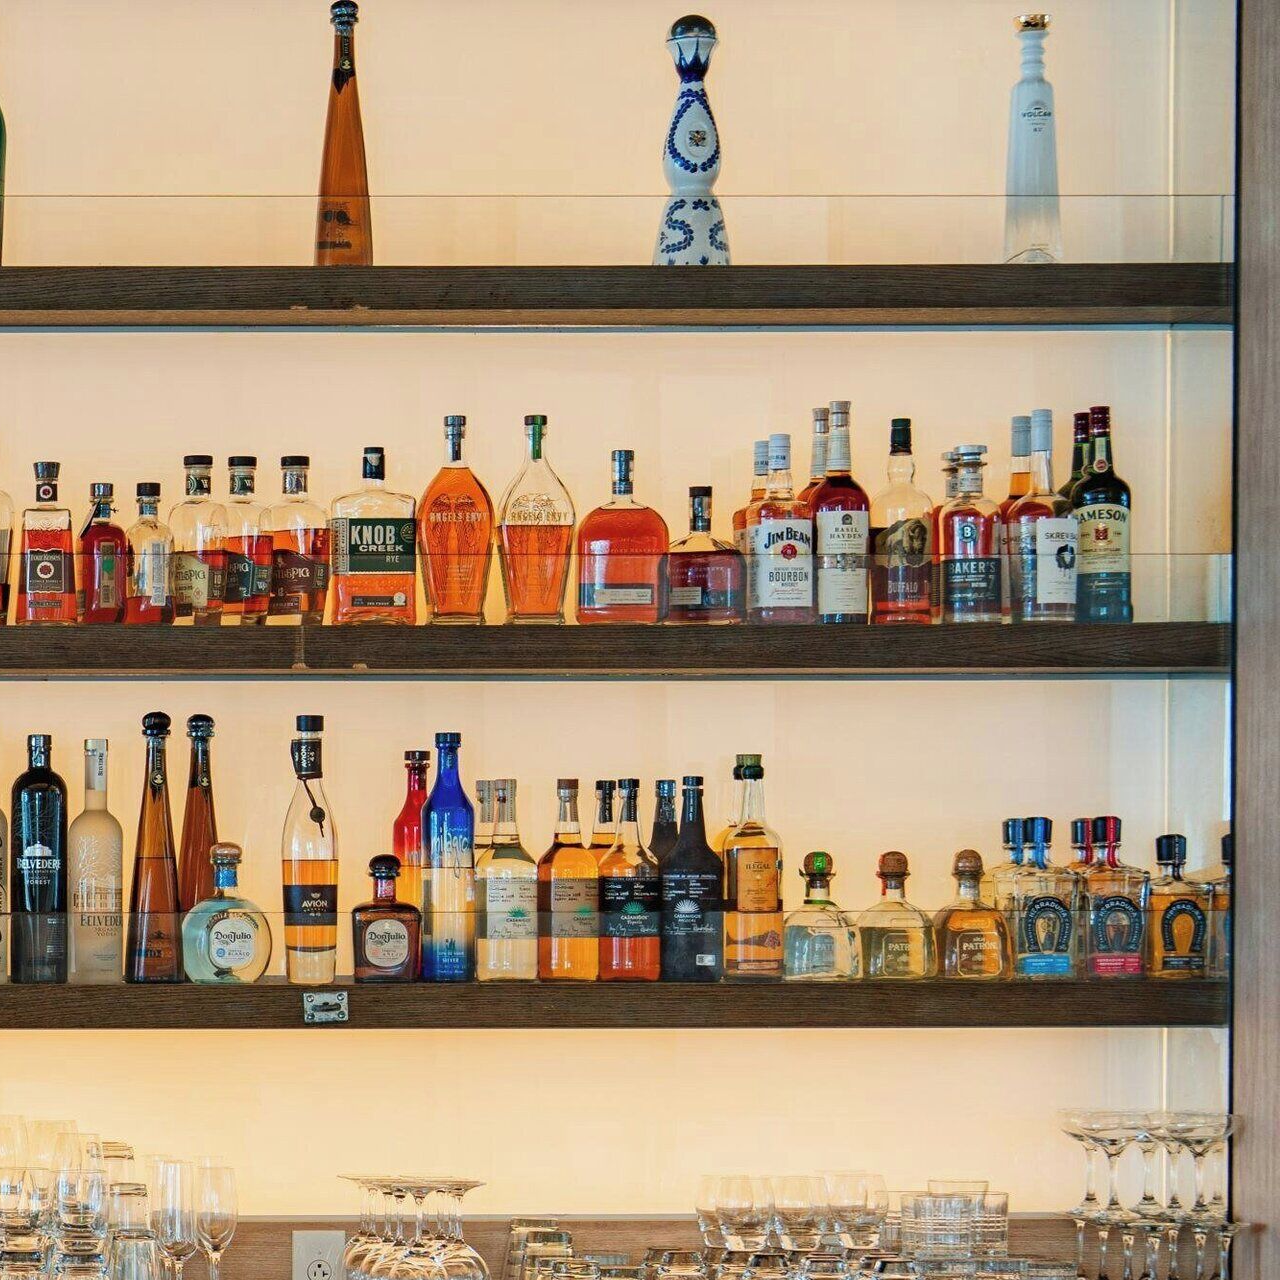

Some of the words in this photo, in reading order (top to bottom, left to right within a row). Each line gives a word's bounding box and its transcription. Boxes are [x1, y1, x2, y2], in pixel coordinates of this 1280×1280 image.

[1076, 508, 1128, 525] JAMESON
[350, 525, 396, 545] KNOB
[764, 530, 785, 549] JIM
[785, 527, 811, 546] BEAM
[358, 544, 404, 552] CREEK
[949, 561, 997, 573] BAKER'S
[767, 572, 809, 583] BOURBON
[886, 580, 918, 594] BUFFALO
[17, 858, 61, 869] BELVEDERE
